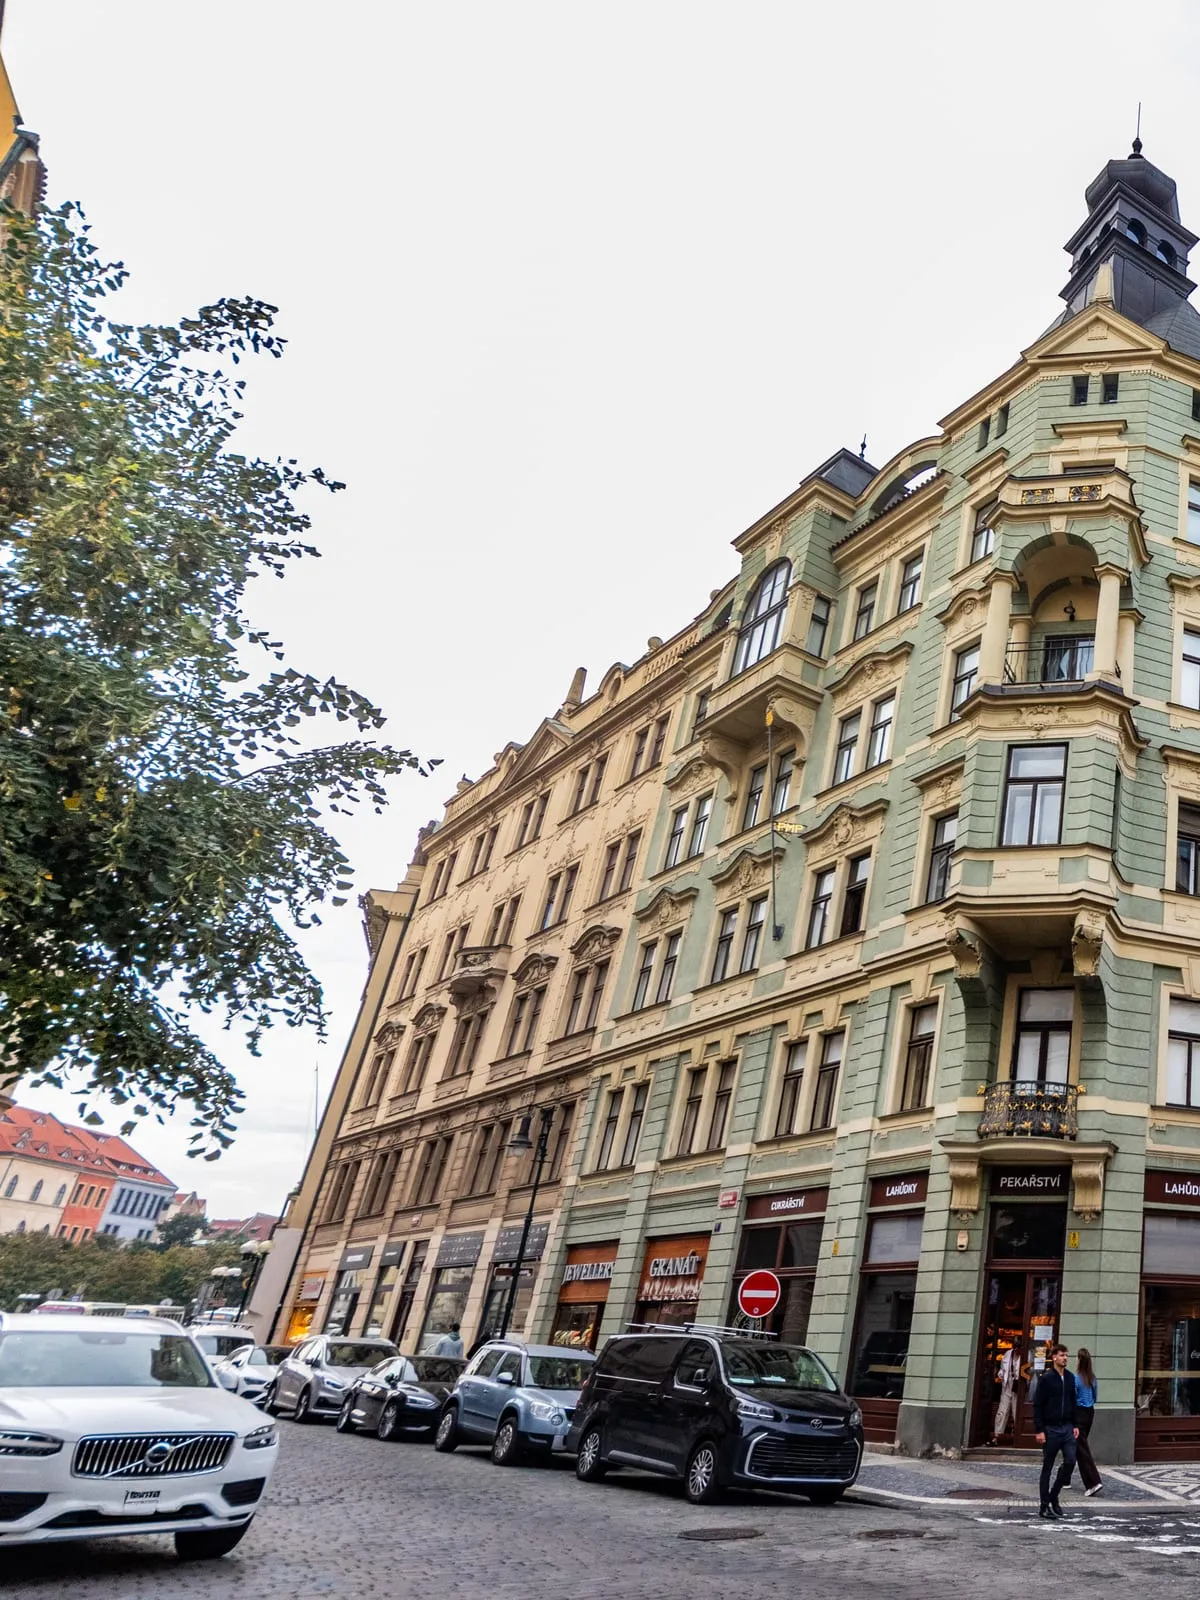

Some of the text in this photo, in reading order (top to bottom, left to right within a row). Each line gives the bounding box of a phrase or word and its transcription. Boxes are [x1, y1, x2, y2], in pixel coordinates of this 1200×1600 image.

[885, 1181, 917, 1197] LAHŮDKY
[1000, 1174, 1061, 1188] PEKAŘSTVÍ
[770, 1195, 806, 1211] CUKRÁŘSTVÍ
[650, 1248, 701, 1277] GRANÁT
